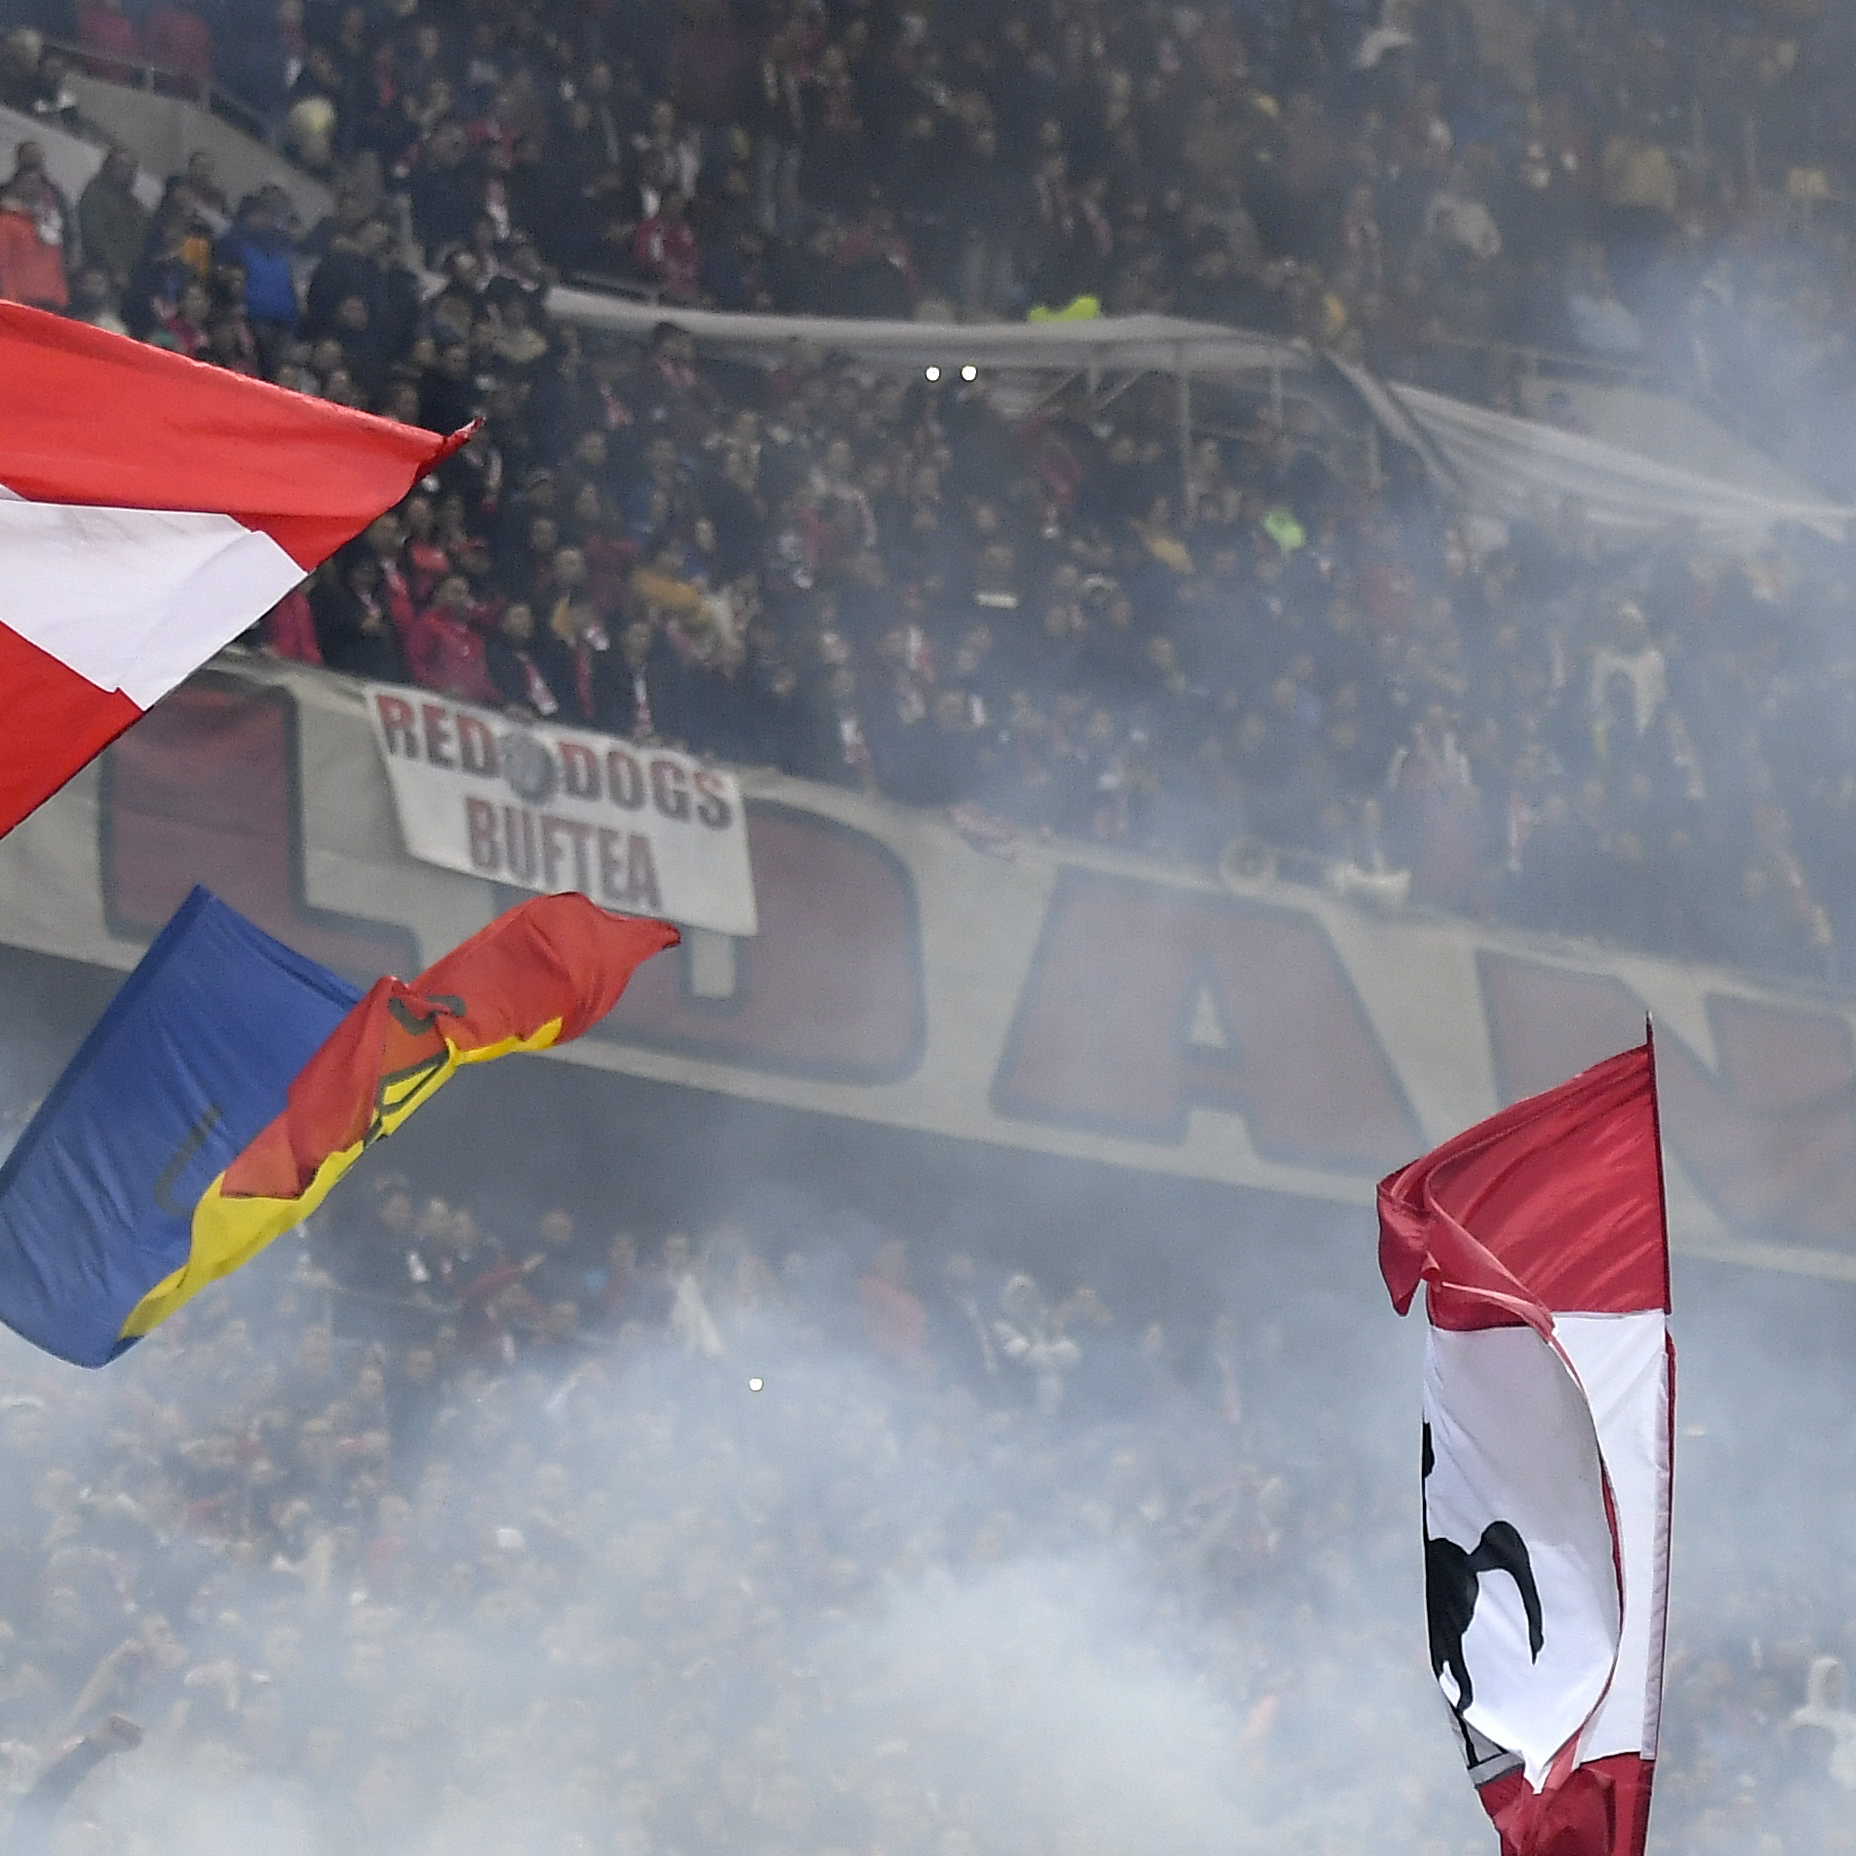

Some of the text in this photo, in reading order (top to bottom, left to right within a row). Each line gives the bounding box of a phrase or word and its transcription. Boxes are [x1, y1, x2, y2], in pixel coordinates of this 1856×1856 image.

[377, 694, 733, 831] RED DOGS
[465, 797, 662, 911] BUFTEA
